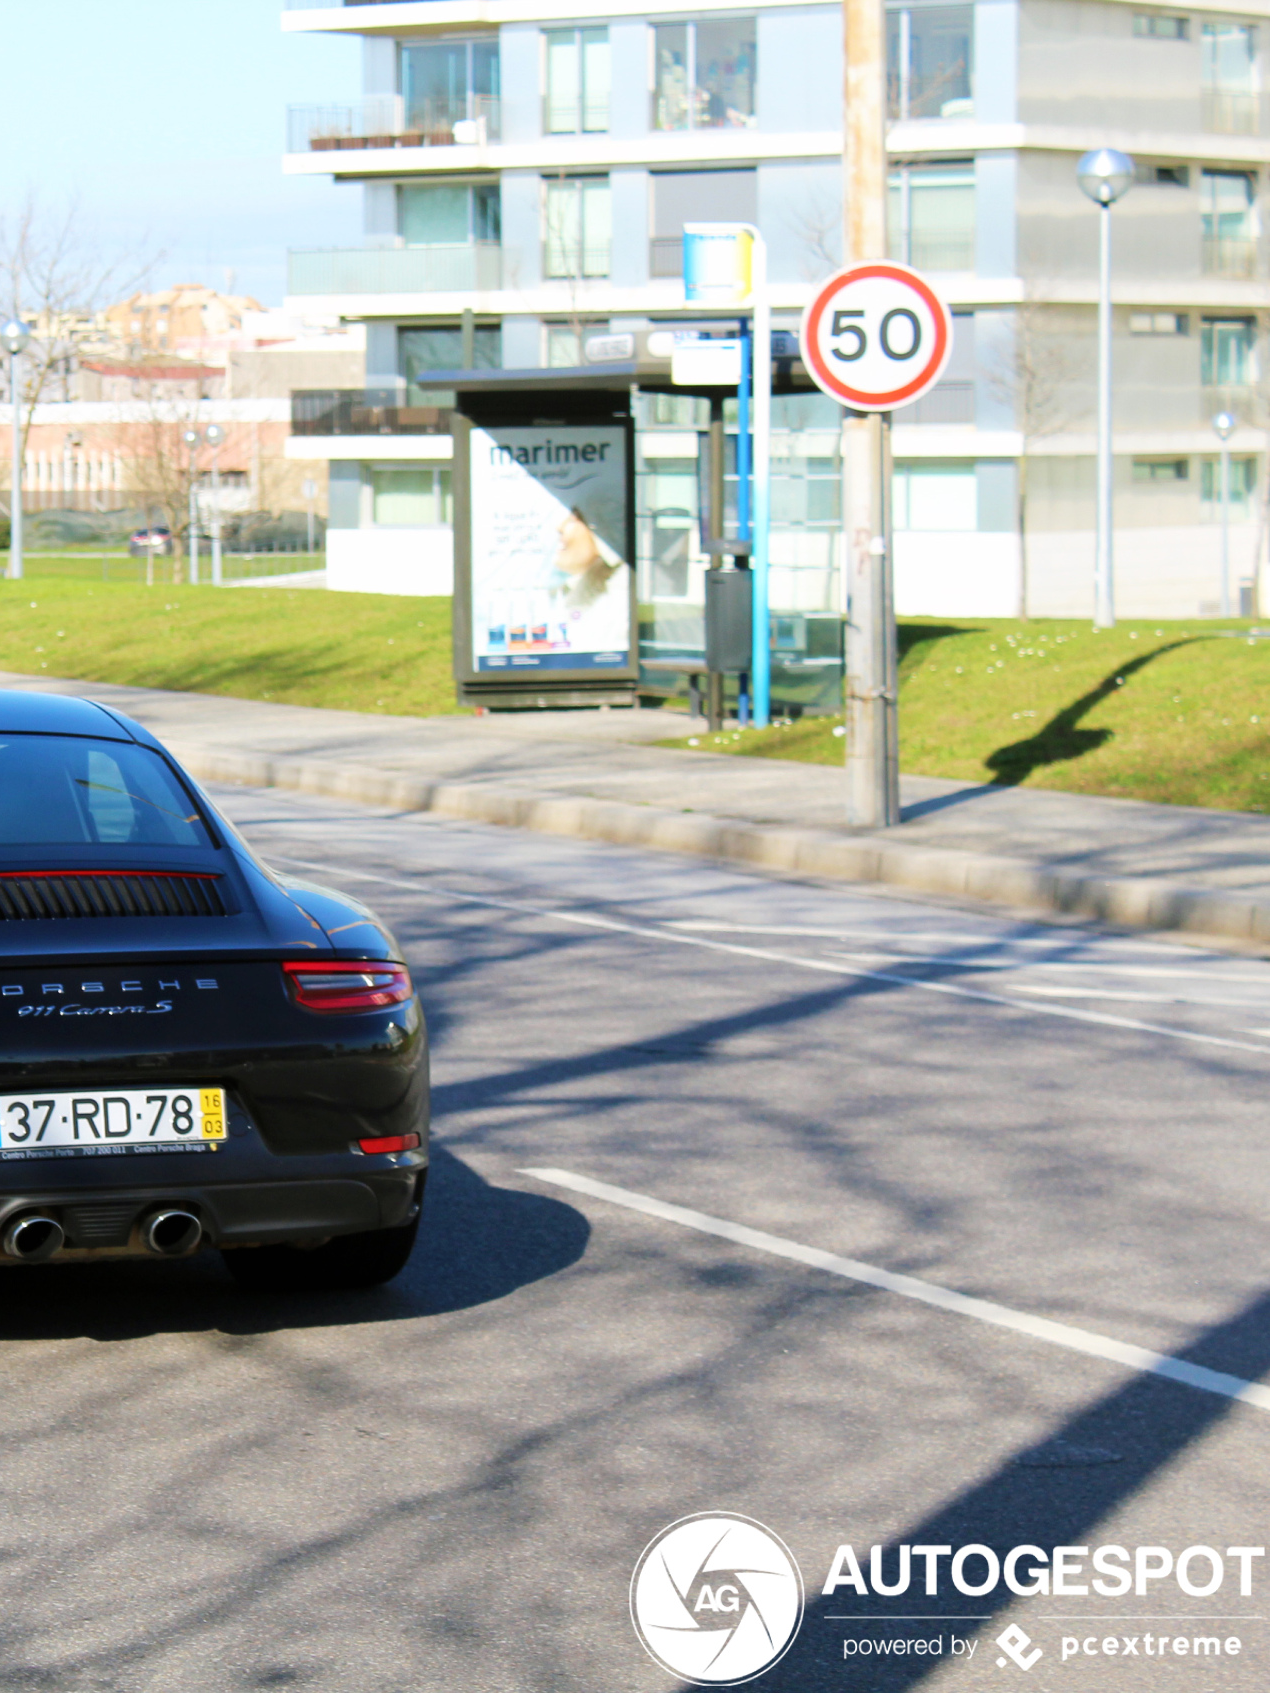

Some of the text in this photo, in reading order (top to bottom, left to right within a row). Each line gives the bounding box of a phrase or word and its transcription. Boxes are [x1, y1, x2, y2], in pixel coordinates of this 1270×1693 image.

[830, 308, 923, 362] 50
[490, 438, 612, 466] marimer
[18, 1000, 173, 1017] 911 Carrera S
[204, 1094, 221, 1108] 16
[204, 1120, 223, 1134] 03
[1, 1152, 26, 1160] Centro
[26, 1150, 54, 1159] Porsche
[133, 1145, 157, 1153] Centro
[157, 1144, 184, 1153] Porsche
